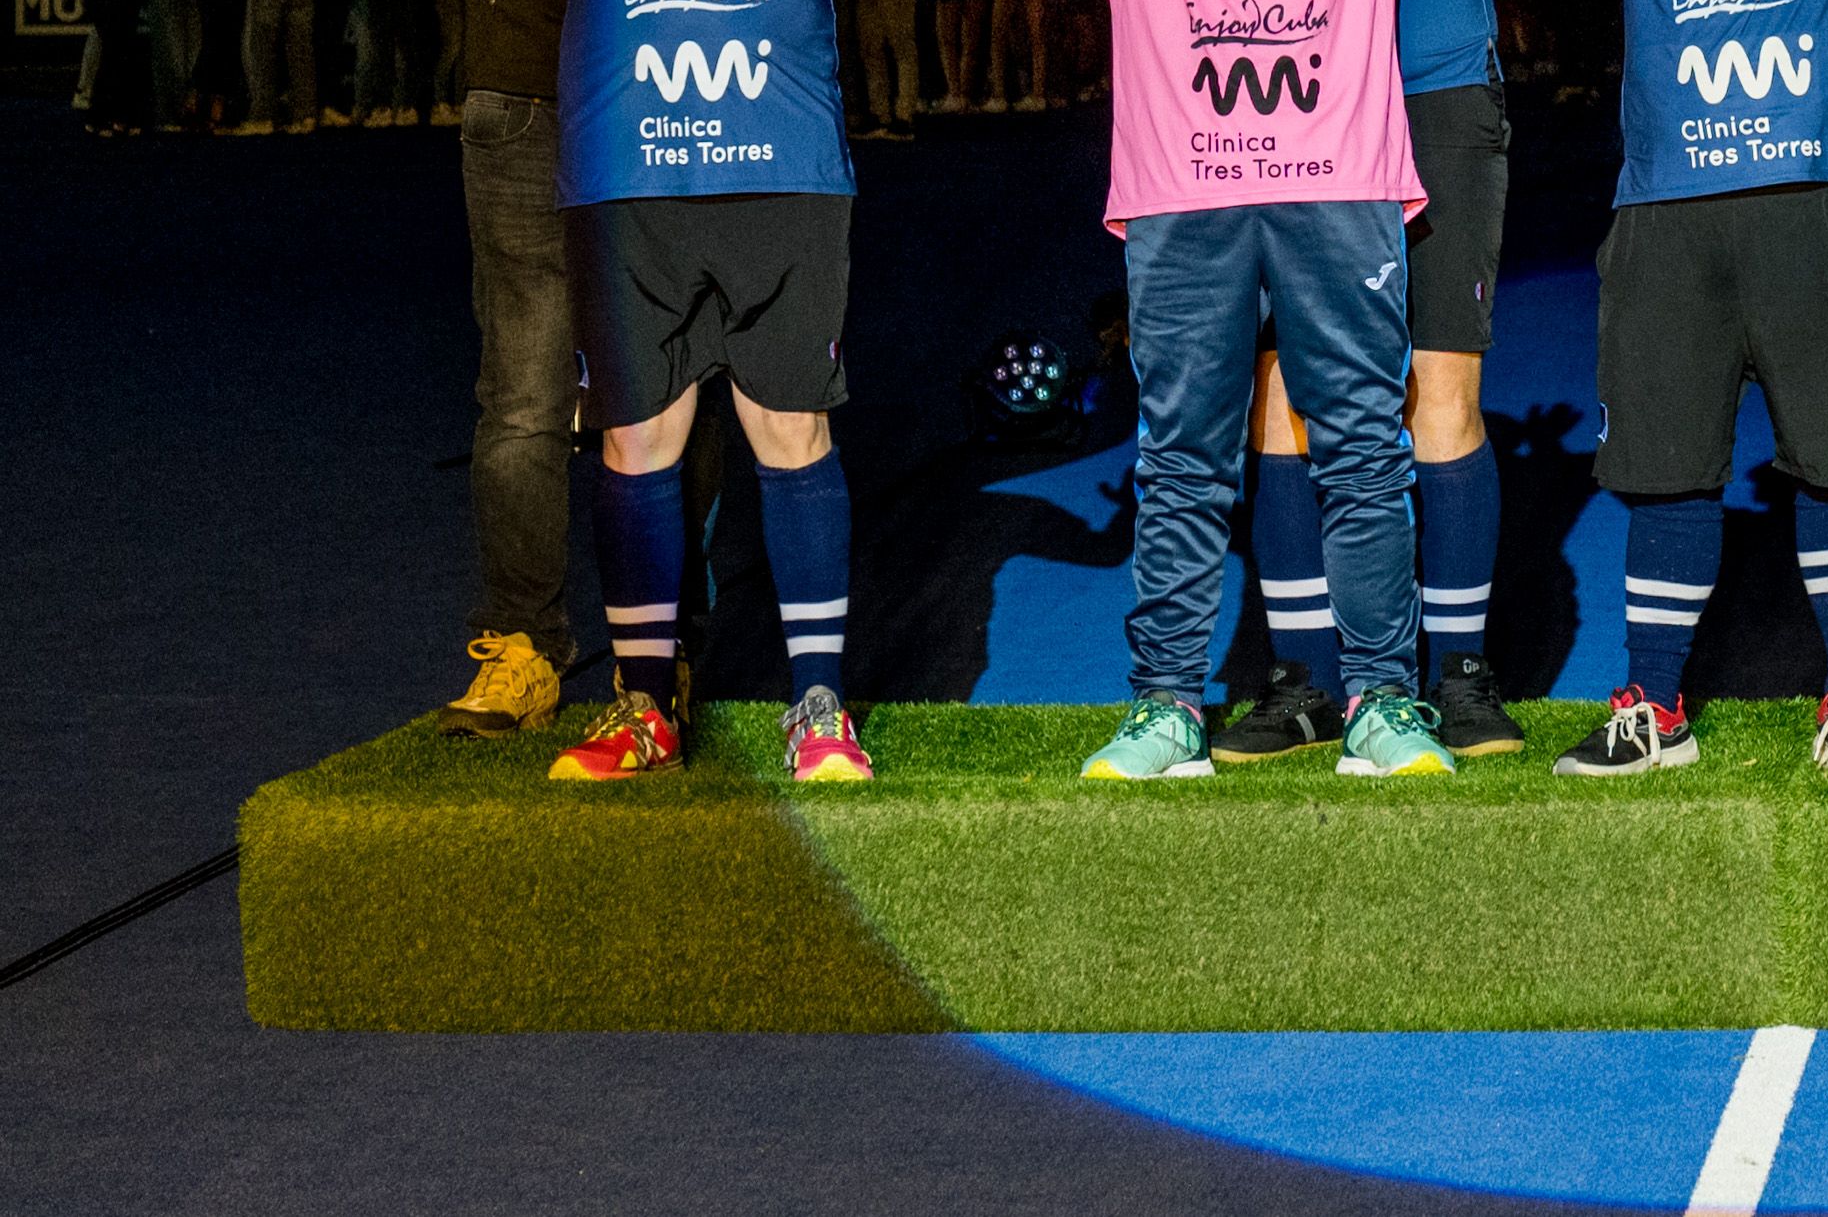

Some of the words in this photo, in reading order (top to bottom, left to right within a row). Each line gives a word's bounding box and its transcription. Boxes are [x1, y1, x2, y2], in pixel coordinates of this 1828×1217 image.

[1263, 0, 1329, 34] Cuba
[639, 115, 722, 140] Clínica
[1681, 114, 1771, 142] Clínica
[640, 143, 690, 167] Tres
[696, 141, 774, 165] Torres
[1190, 131, 1277, 153] Clínica
[1686, 146, 1740, 170] Tres
[1745, 138, 1823, 163] Torres
[1190, 159, 1244, 180] Tres
[1252, 158, 1335, 179] Torres
